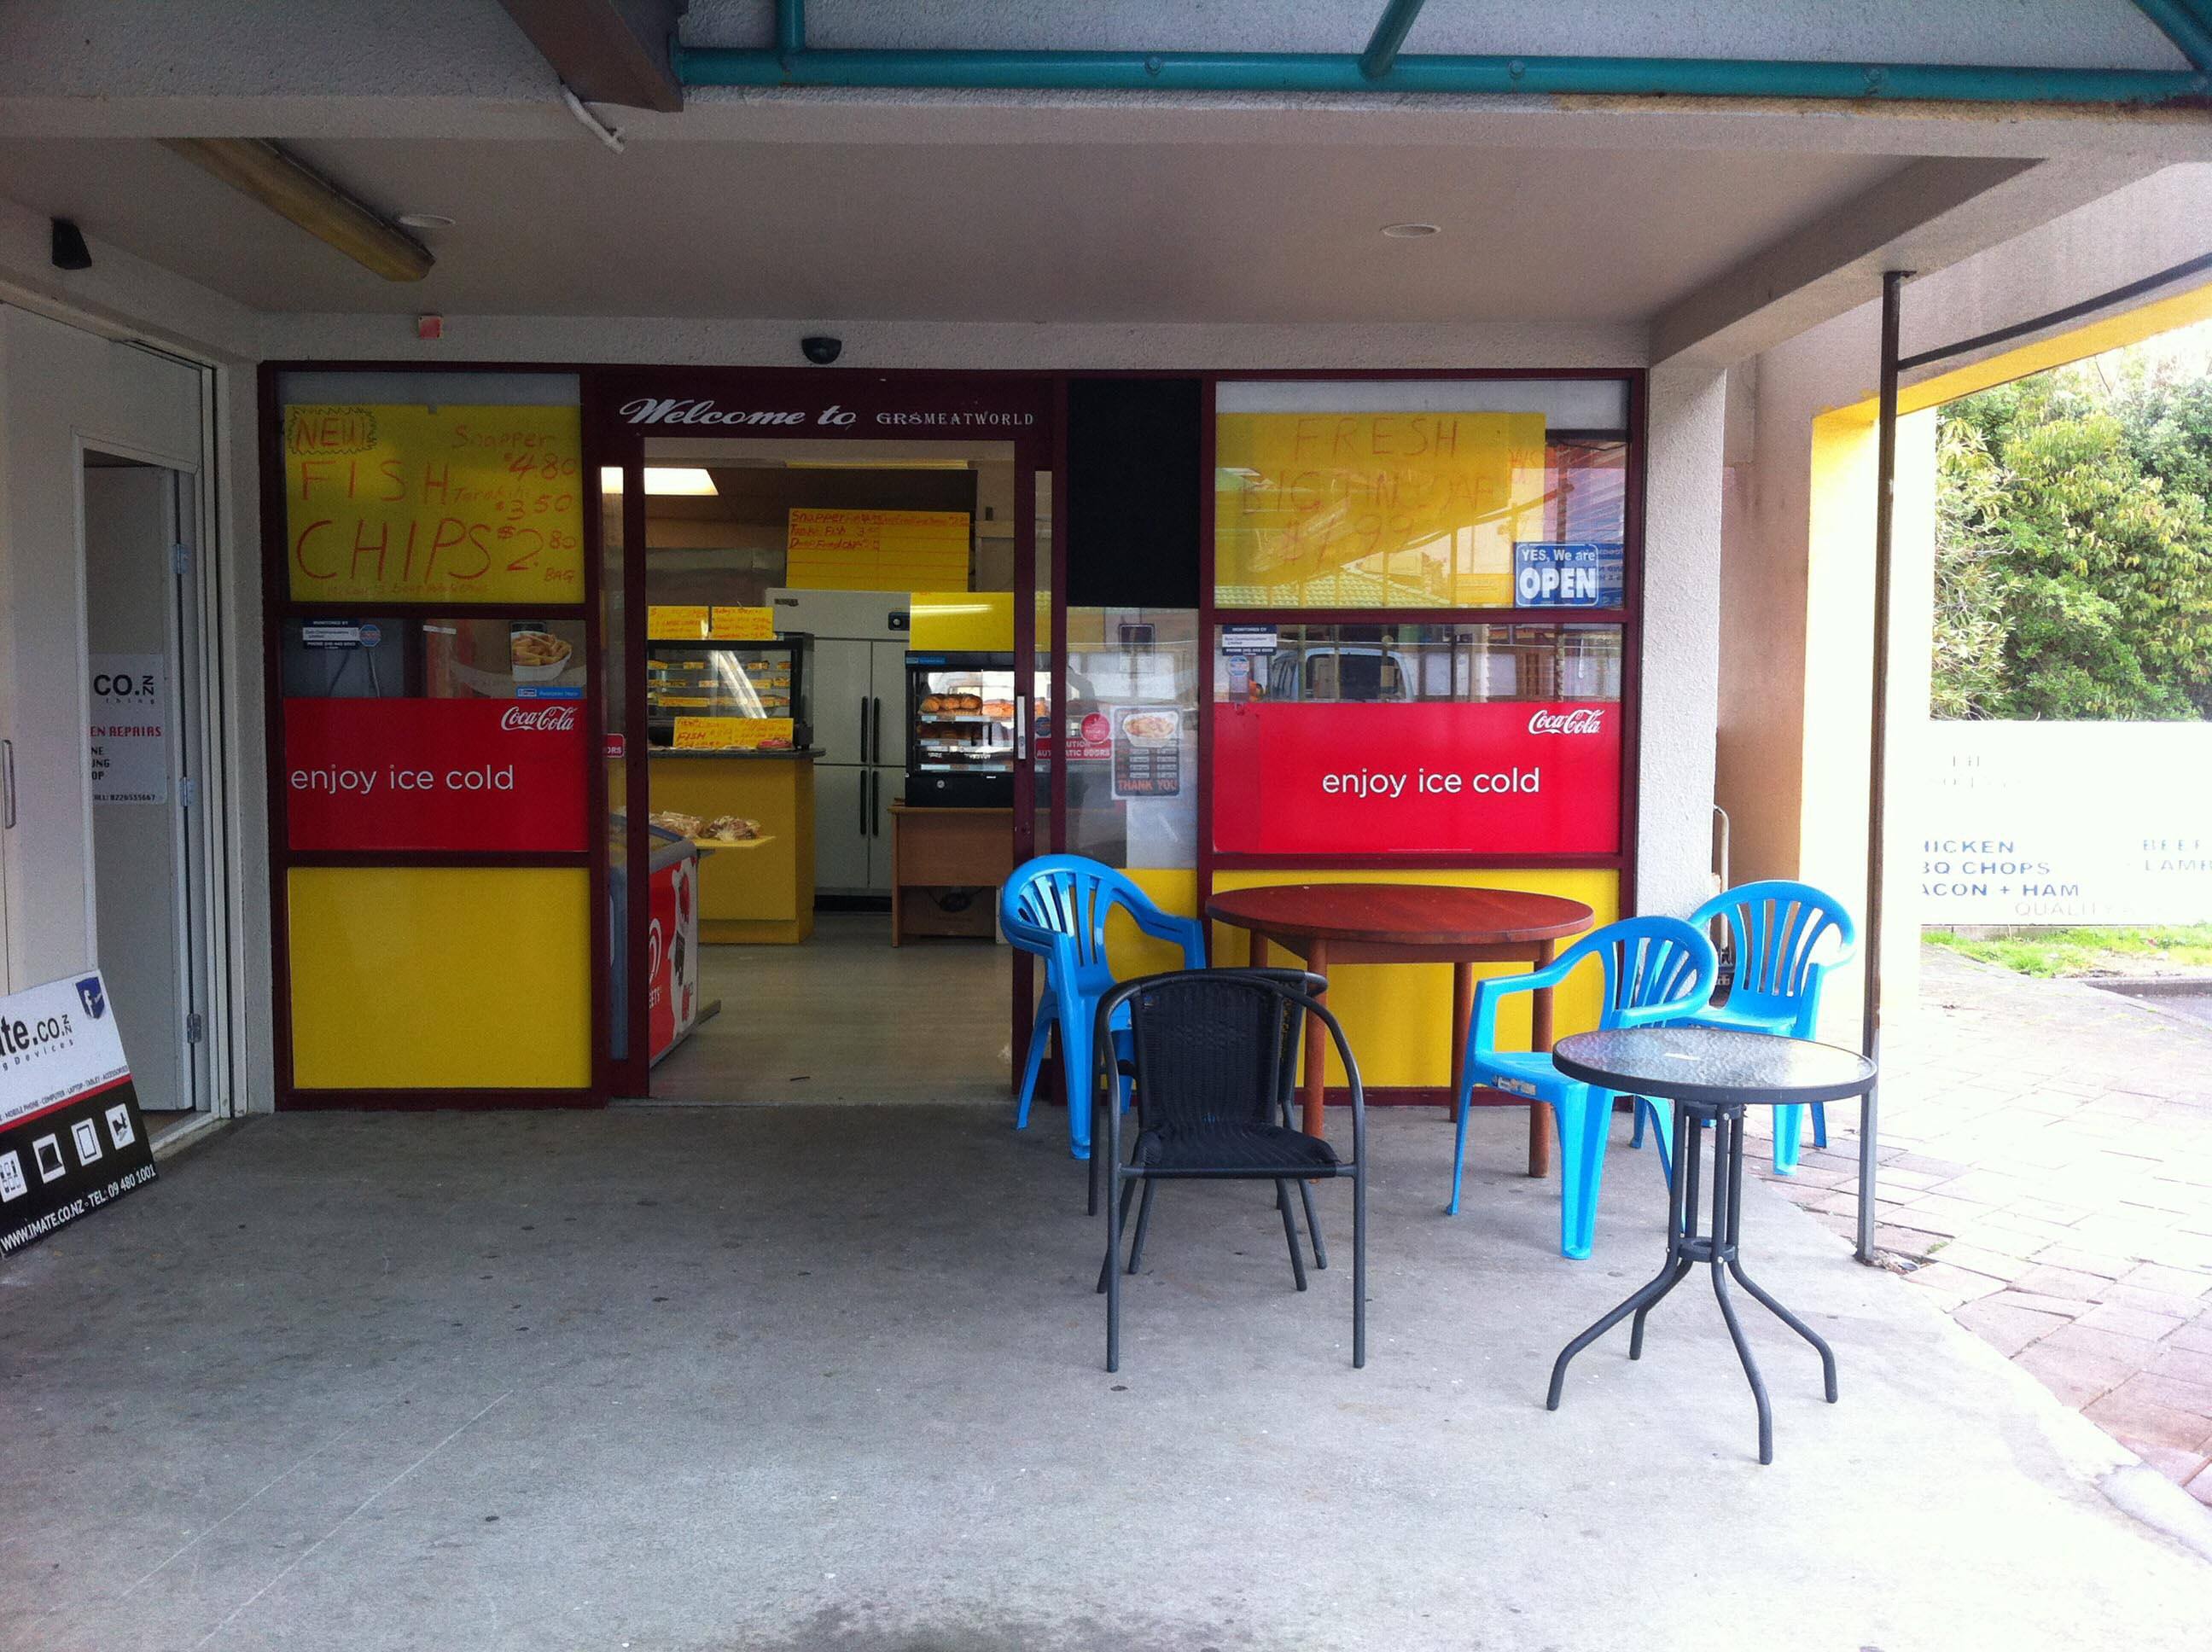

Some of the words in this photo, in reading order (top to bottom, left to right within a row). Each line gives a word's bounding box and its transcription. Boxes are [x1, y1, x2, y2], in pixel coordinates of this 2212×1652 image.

[619, 398, 806, 425] Welcome
[817, 405, 856, 428] to
[296, 417, 365, 450] NEW
[1294, 416, 1458, 462] FRESH
[300, 461, 450, 505] FISH
[297, 517, 492, 582] CHIPS
[1522, 550, 1550, 561] YES,
[1553, 550, 1572, 561] We
[1575, 550, 1596, 561] are
[1519, 567, 1597, 599] OPEN
[109, 726, 162, 736] REPAIRS
[291, 765, 377, 794] enjoy
[390, 765, 434, 790] ice
[445, 765, 514, 790] cold
[1119, 778, 1153, 791] THANK
[1158, 778, 1178, 791] YOU
[1322, 768, 1406, 798] enjoy
[1418, 768, 1462, 793] ice
[1472, 768, 1540, 793] cold
[1963, 861, 2051, 875] CHOPS
[2023, 884, 2079, 896] HAM
[108, 1182, 119, 1198] 09
[120, 1173, 136, 1191] 480
[137, 1164, 156, 1184] 1001
